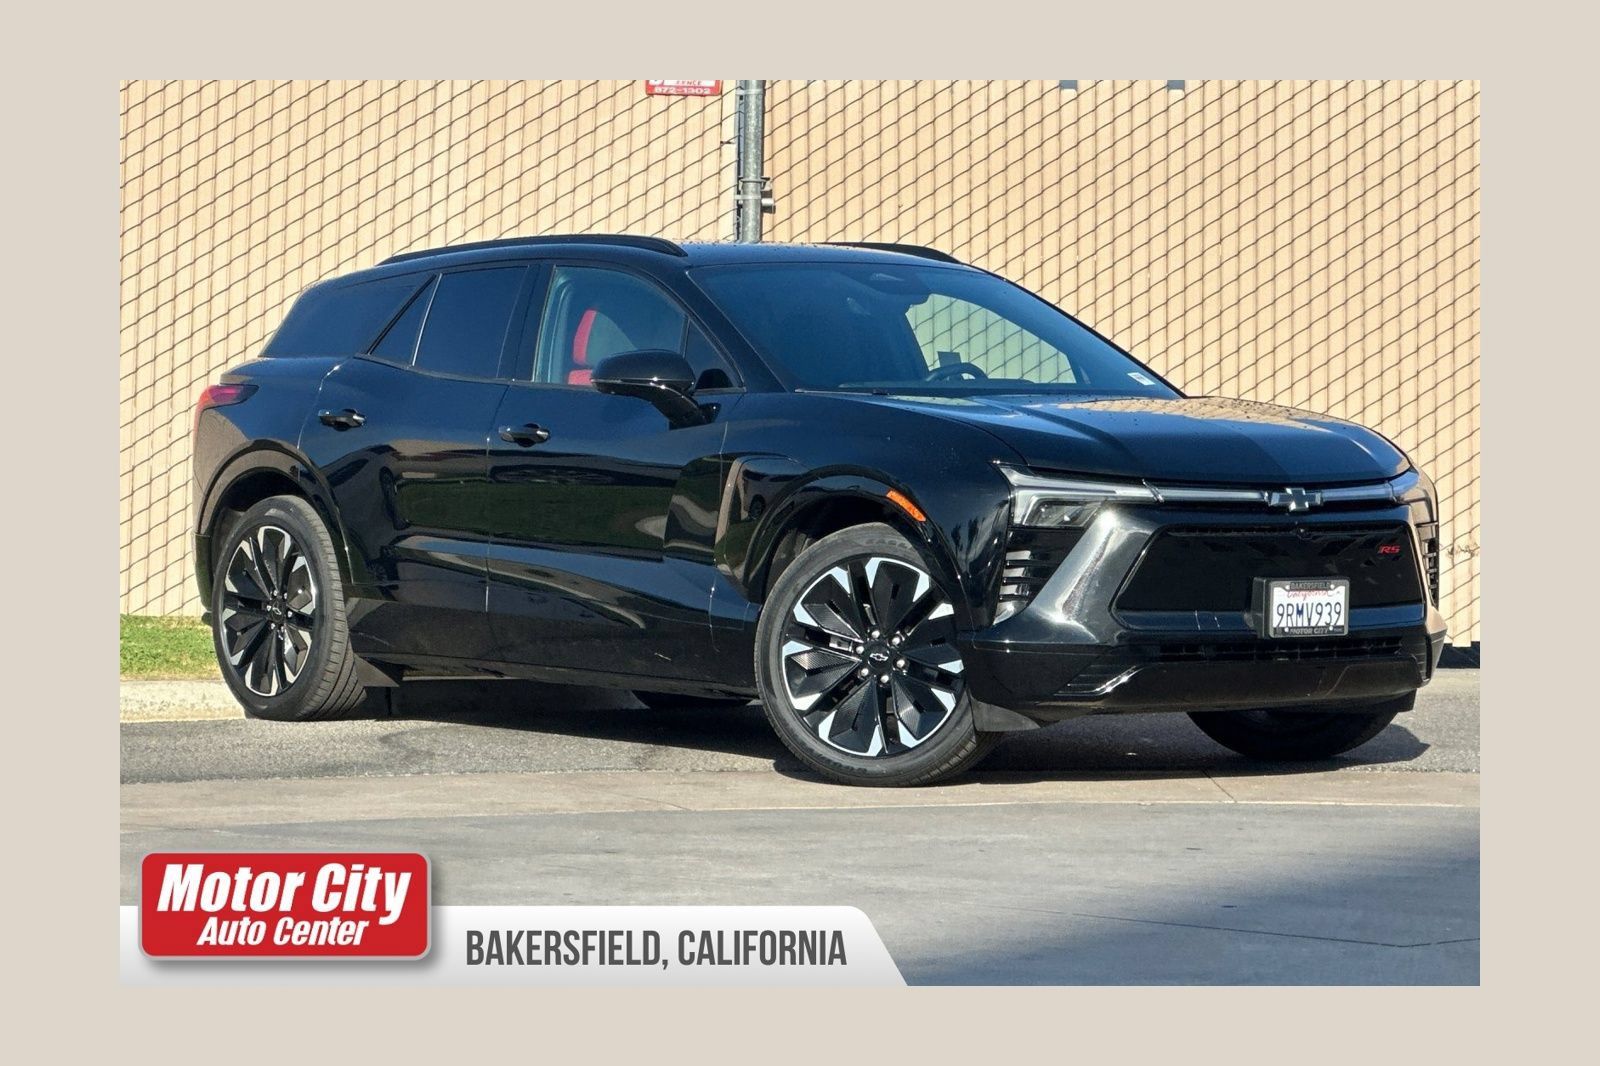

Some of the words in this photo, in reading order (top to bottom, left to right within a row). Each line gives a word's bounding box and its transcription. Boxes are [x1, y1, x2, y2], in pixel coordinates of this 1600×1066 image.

[1377, 545, 1400, 554] RS
[1276, 602, 1342, 627] 9RMV939
[1290, 627, 1313, 635] MOTOR
